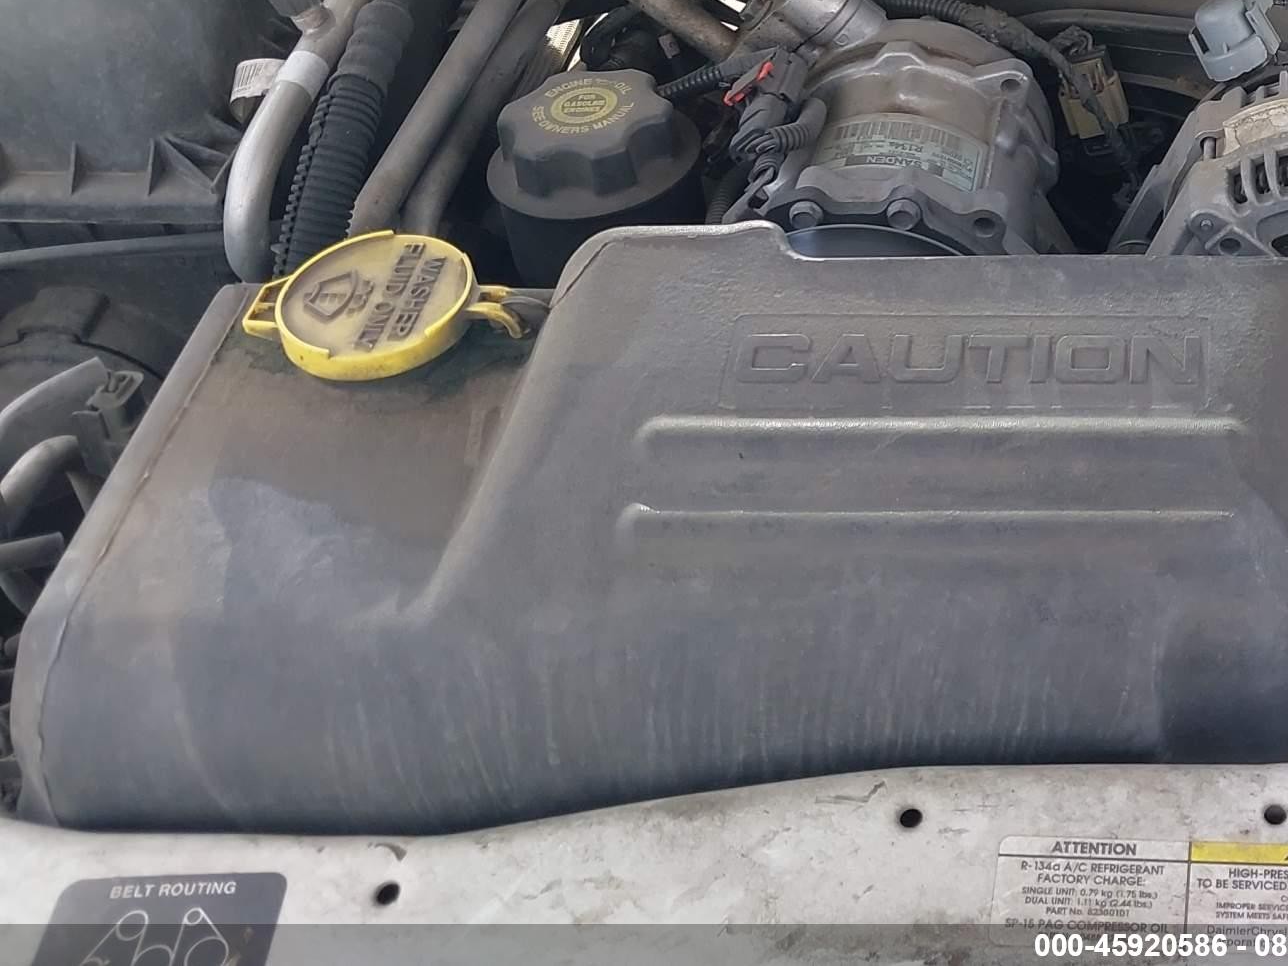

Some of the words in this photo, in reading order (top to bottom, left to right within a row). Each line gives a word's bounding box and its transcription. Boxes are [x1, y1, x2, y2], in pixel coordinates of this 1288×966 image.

[544, 78, 592, 98] ENGINE
[592, 102, 635, 130] MANUAL
[867, 155, 922, 169] SANDEN
[381, 241, 425, 297] FLUID
[386, 255, 447, 342] WASHER
[354, 302, 393, 353] ONLY
[734, 334, 1201, 385] CAUTION
[1051, 841, 1137, 856] ATTENTION
[1021, 860, 1061, 872] R-134a
[1064, 861, 1087, 873] A/C
[1090, 863, 1165, 875] REFRIGERANT
[1037, 873, 1090, 885] FACTORY
[1093, 875, 1146, 886] CHARGE:
[1197, 878, 1212, 889] TO
[1216, 878, 1229, 889] BE
[1231, 879, 1287, 891] SERVICED
[109, 883, 154, 899] BELT
[158, 881, 237, 897] ROUTING
[1022, 886, 1051, 895] SINGLE
[1101, 889, 1113, 899] kg
[1025, 896, 1049, 905] DUAL
[1095, 898, 1107, 908] kg
[1216, 901, 1257, 910] IMPROPER
[1258, 902, 1288, 911] SERVICE
[1045, 906, 1067, 915] PART
[1215, 911, 1245, 920] SYSTEM
[1038, 919, 1064, 930] PAG
[1066, 921, 1147, 934] COMPRESSOR
[1150, 923, 1168, 934] OIL
